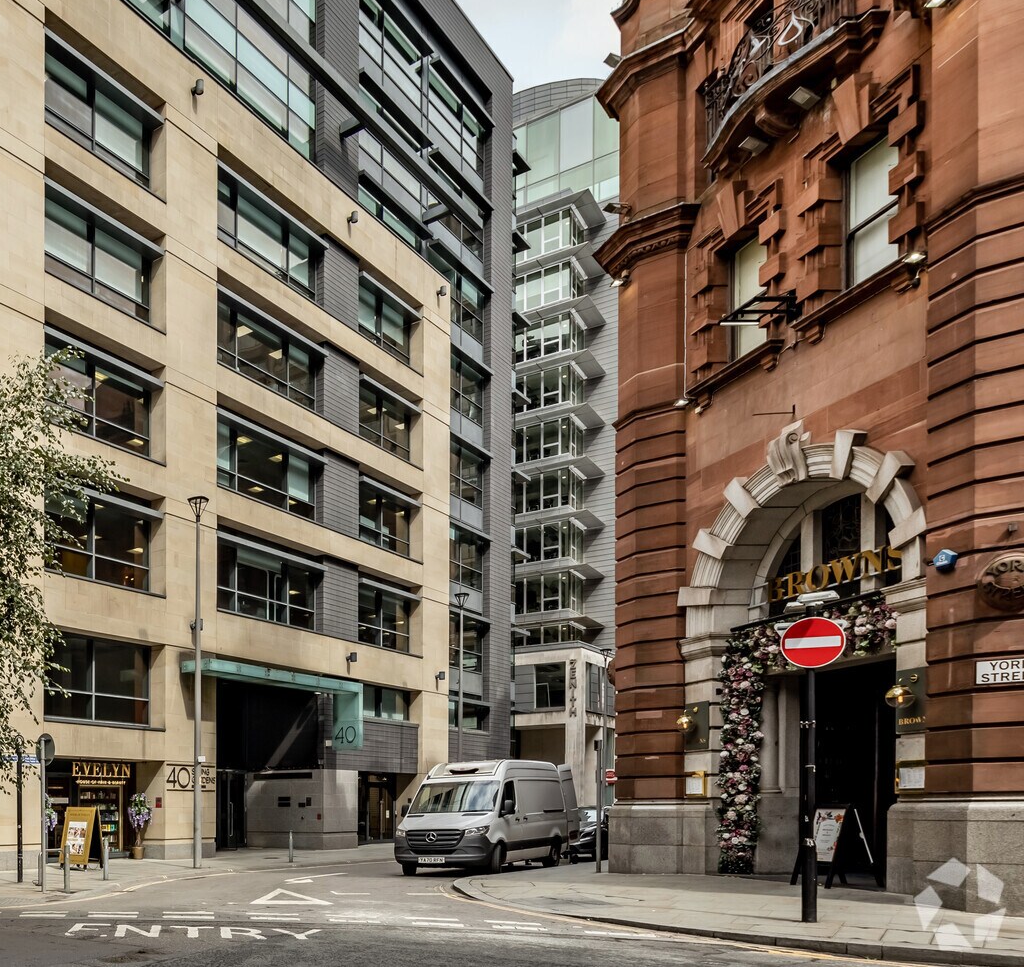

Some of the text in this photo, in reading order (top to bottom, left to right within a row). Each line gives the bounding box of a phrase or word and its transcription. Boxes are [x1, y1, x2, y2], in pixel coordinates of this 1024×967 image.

[767, 545, 902, 603] BROWNS
[984, 559, 1024, 578] YOR
[989, 660, 1024, 671] YOR
[981, 671, 1024, 683] STRE
[569, 658, 577, 718] ZENITH
[334, 725, 356, 744] 40
[72, 761, 131, 778] EVELYN
[166, 766, 191, 789] 40
[65, 923, 323, 940] ENTRY
